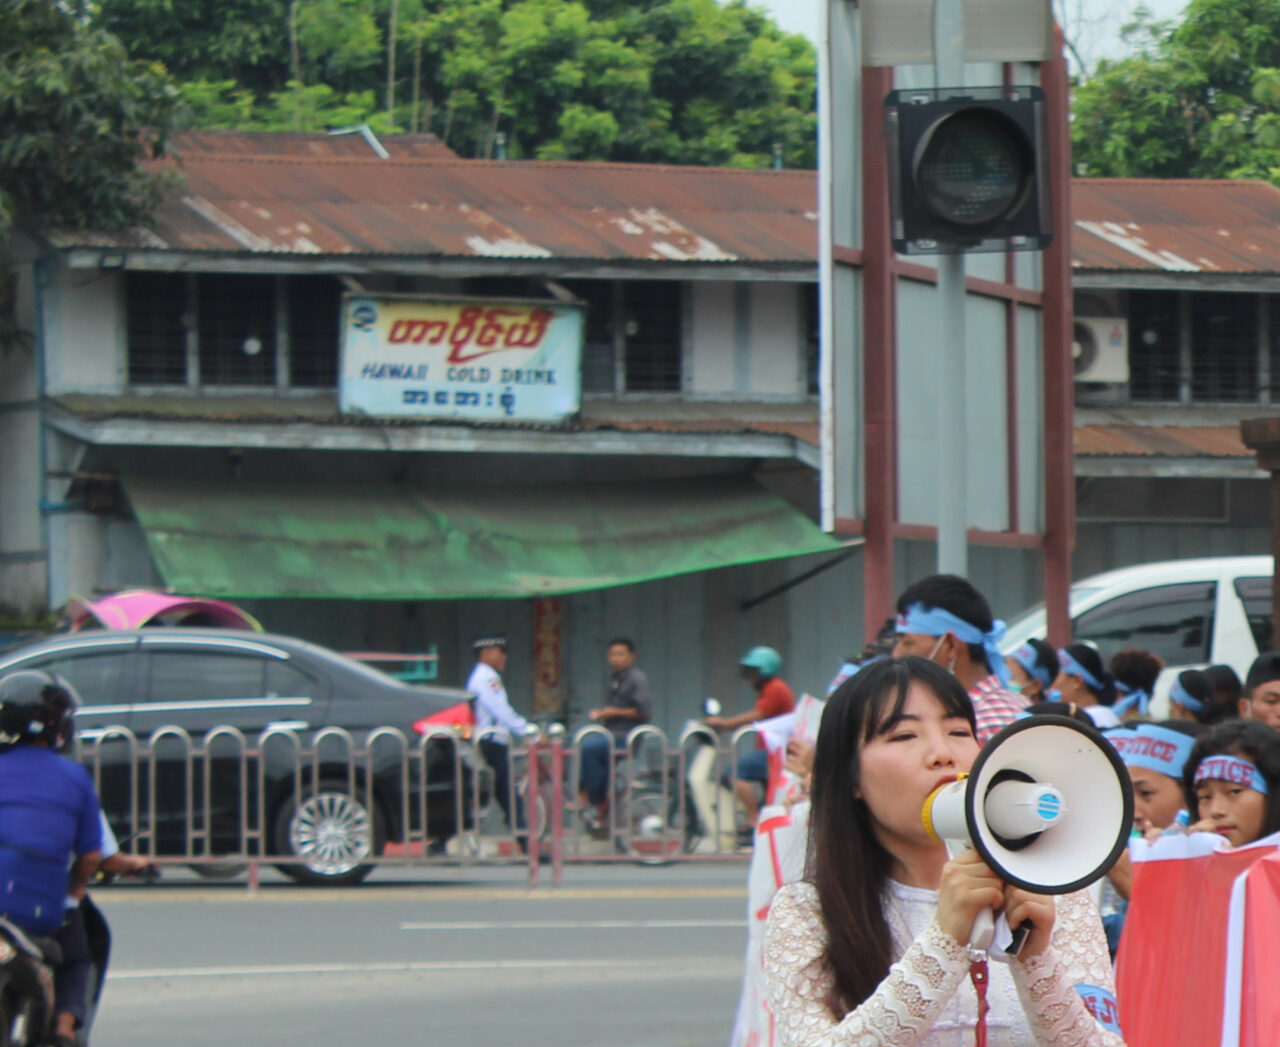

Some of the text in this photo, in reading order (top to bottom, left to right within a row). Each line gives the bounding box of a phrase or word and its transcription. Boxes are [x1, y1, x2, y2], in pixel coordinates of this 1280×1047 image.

[361, 362, 556, 385] HAWAII COLD DRINK
